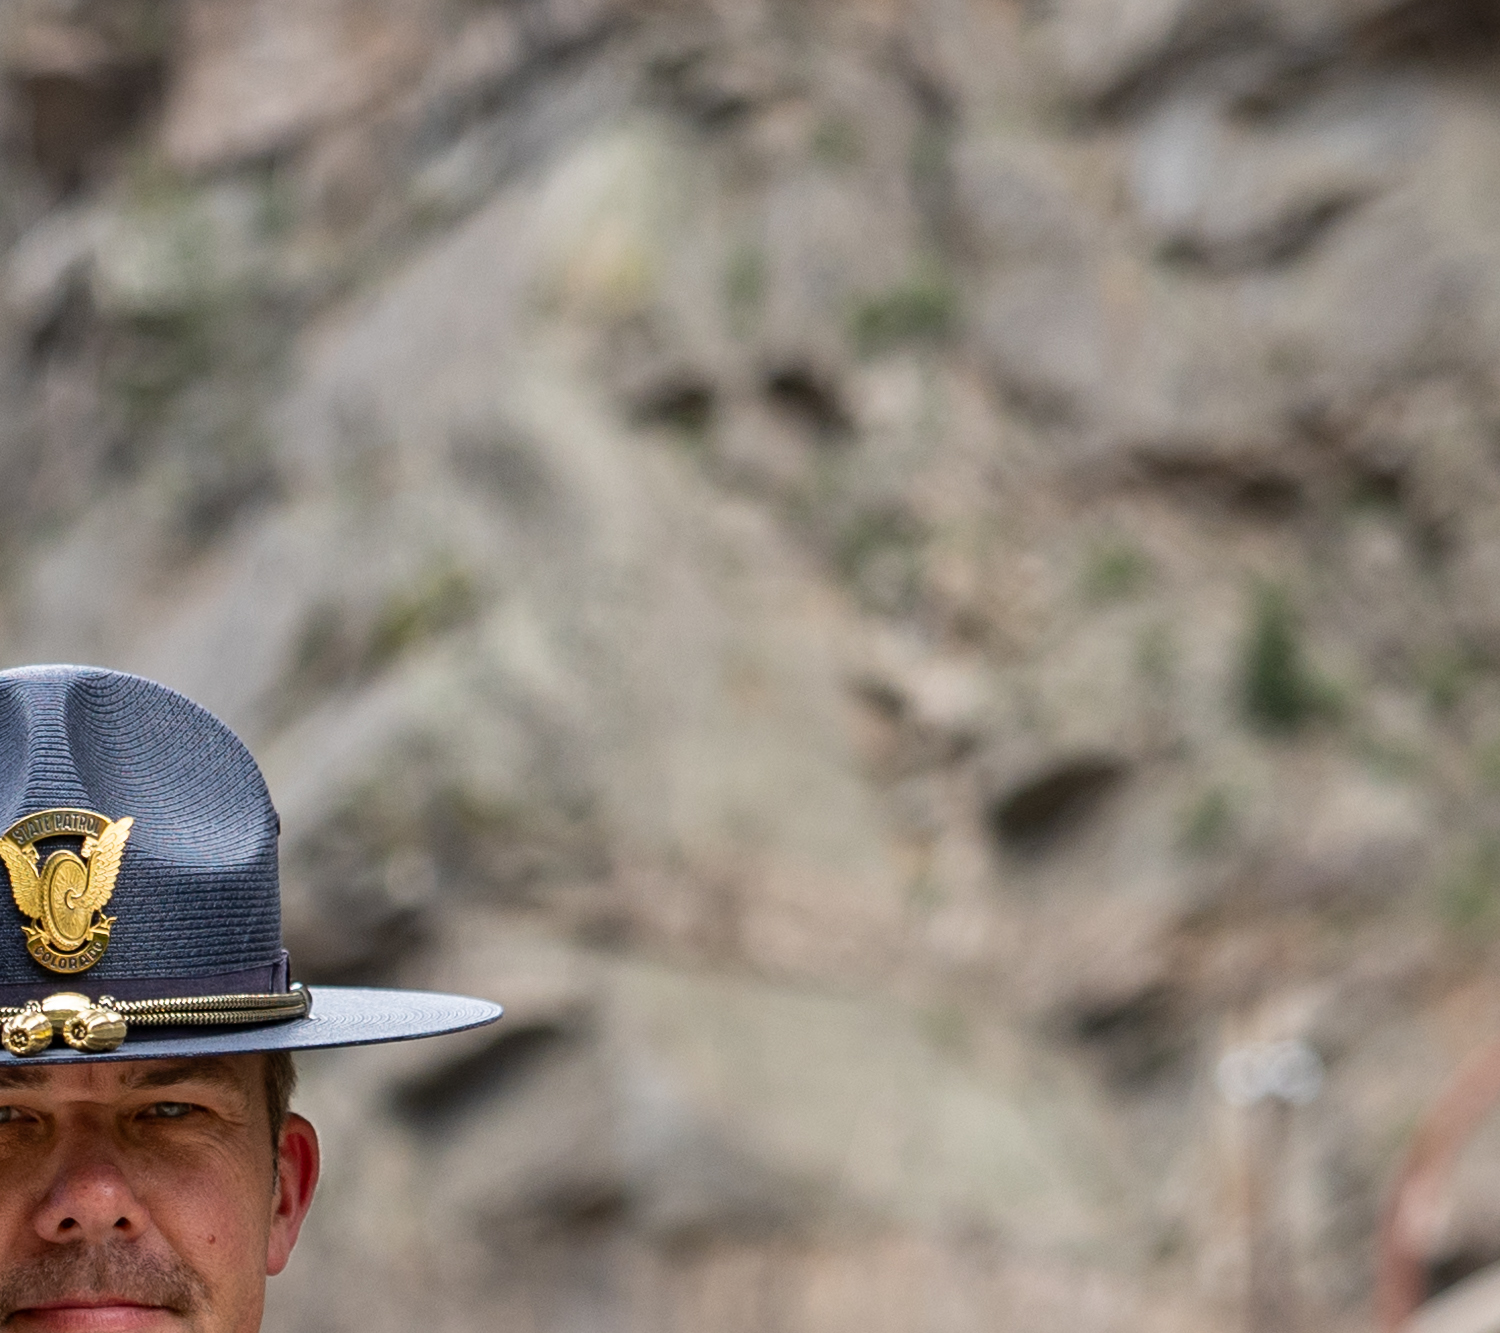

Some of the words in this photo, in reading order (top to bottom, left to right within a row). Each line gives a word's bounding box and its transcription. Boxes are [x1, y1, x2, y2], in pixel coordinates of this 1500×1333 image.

[12, 818, 50, 845] STATE
[53, 813, 100, 838] PATROL
[34, 941, 103, 970] COLORADO
